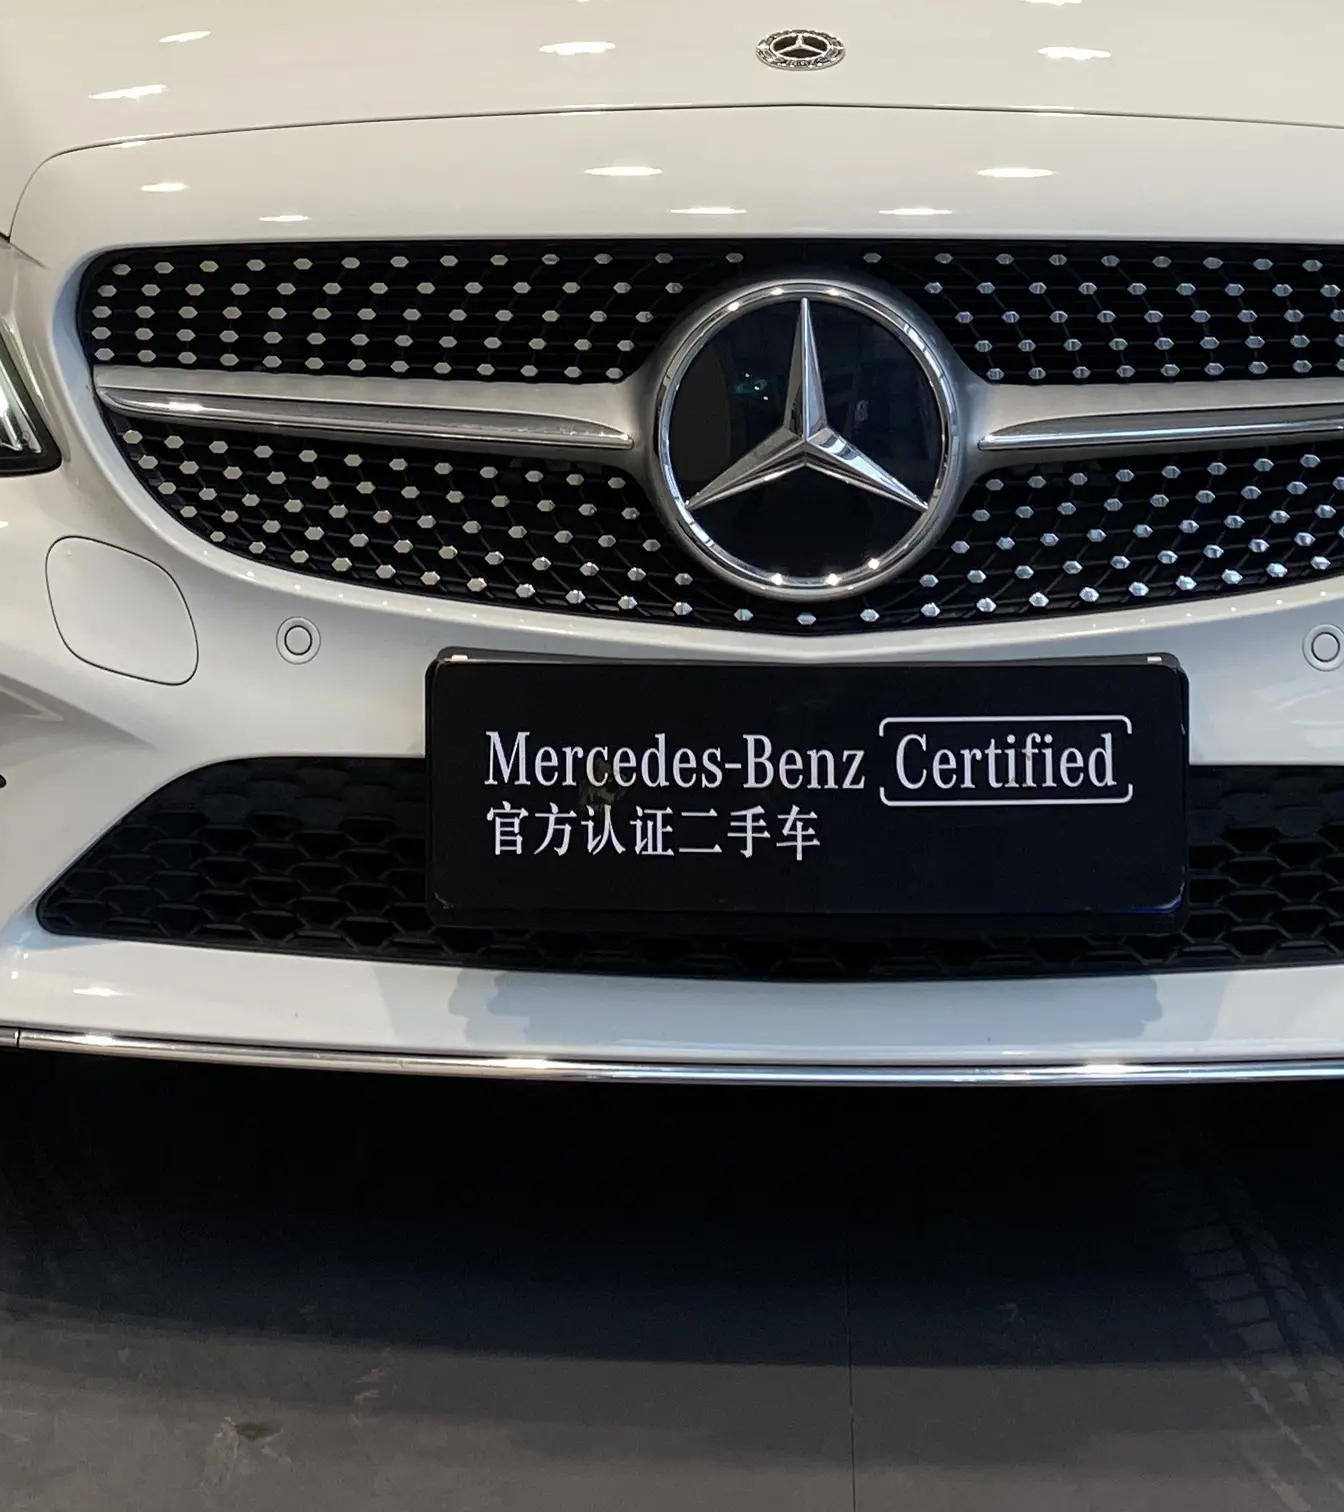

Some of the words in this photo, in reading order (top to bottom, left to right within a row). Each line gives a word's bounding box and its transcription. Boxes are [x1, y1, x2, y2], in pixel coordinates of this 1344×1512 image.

[484, 731, 866, 790] Mercedes-Benz
[896, 732, 1116, 790] Certified
[486, 800, 821, 861] 官方认证二手车
